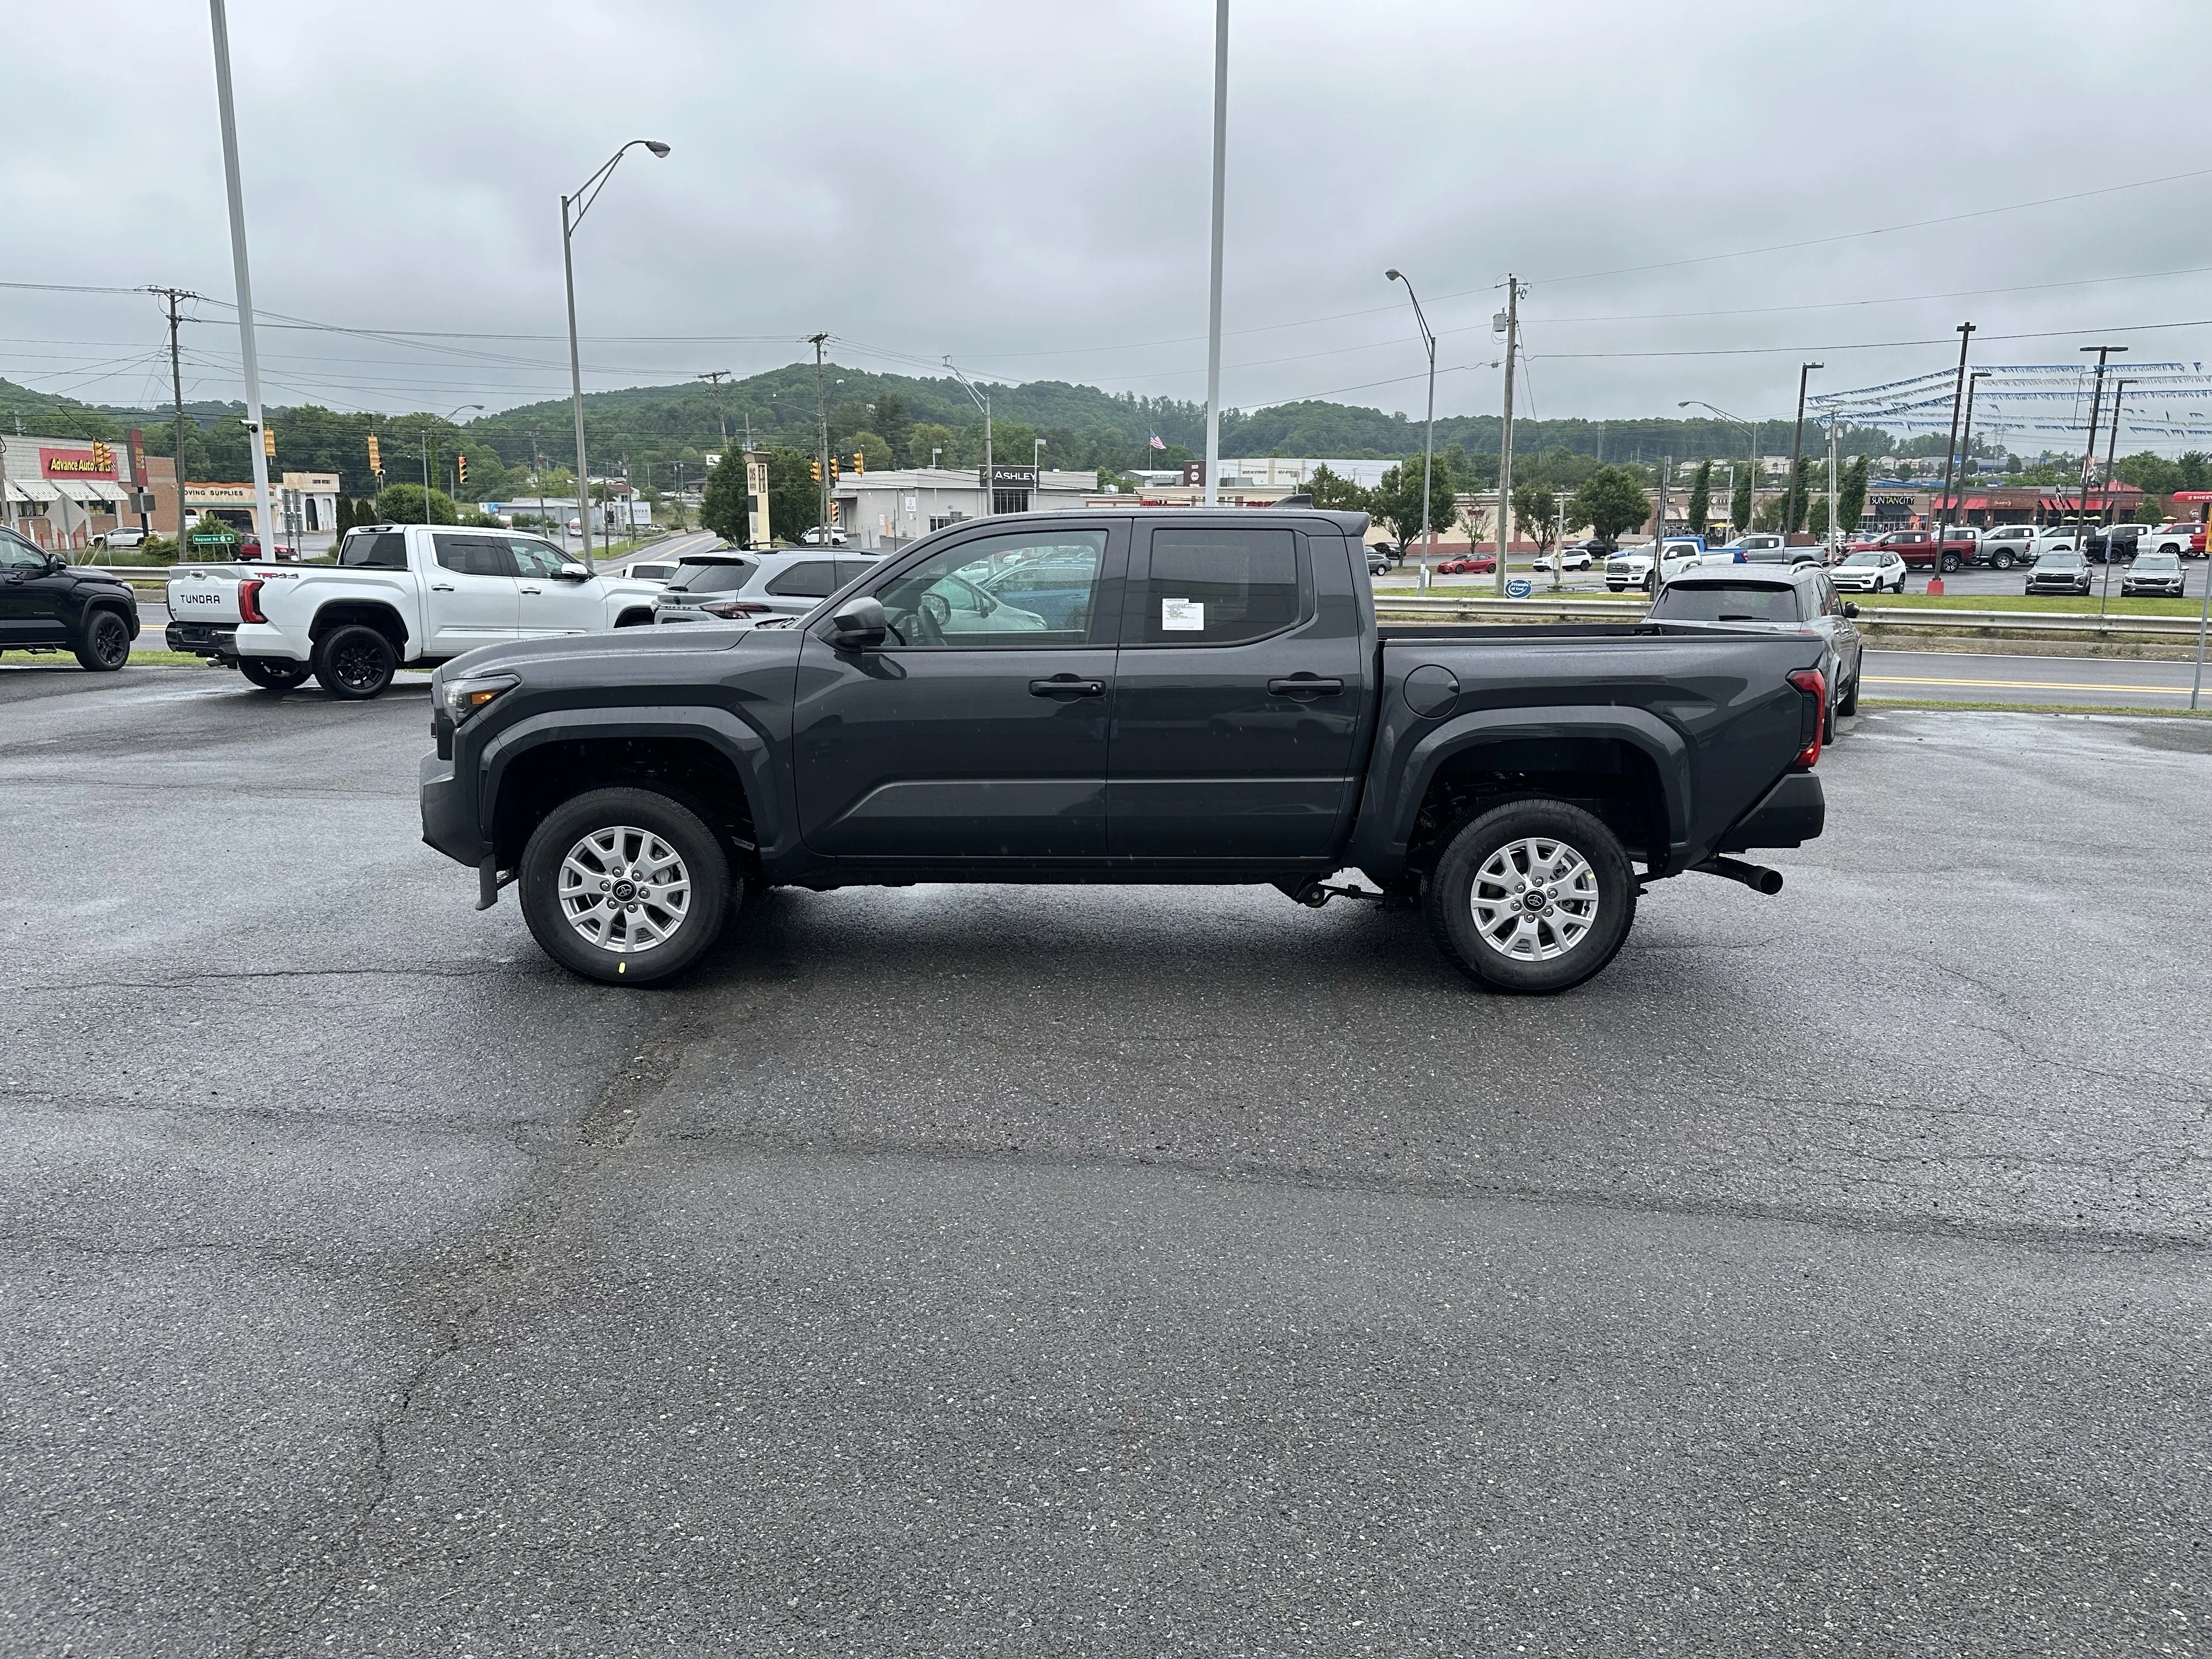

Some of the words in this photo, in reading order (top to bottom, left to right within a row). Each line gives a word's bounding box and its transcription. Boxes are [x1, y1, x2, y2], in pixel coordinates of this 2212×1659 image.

[50, 458, 78, 471] Advance
[78, 459, 94, 471] Auto
[994, 471, 1036, 480] ASHLEY
[180, 595, 221, 604] TUNDRA
